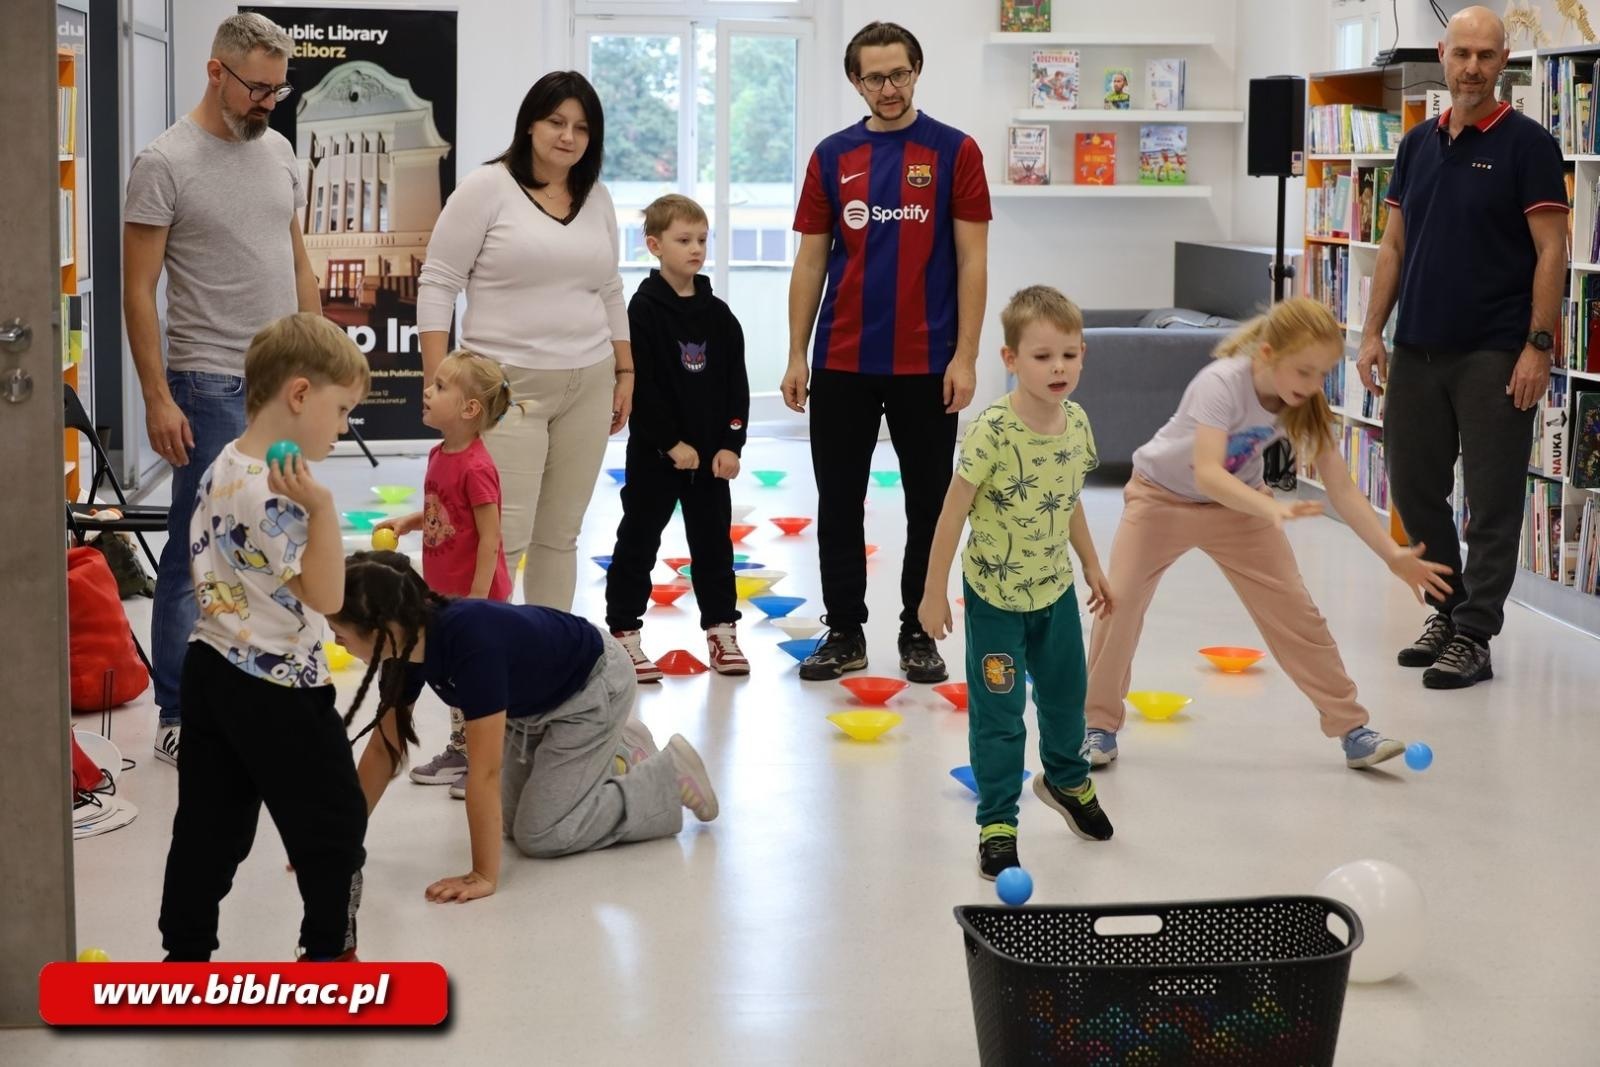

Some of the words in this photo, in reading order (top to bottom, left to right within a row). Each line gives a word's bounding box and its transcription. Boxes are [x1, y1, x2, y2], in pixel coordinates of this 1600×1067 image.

[282, 24, 324, 40] ublic
[328, 25, 388, 45] Library
[293, 42, 346, 58] ciborz
[872, 204, 930, 223] Spotify
[389, 369, 424, 378] Publiczn
[1552, 432, 1562, 475] NAUKA
